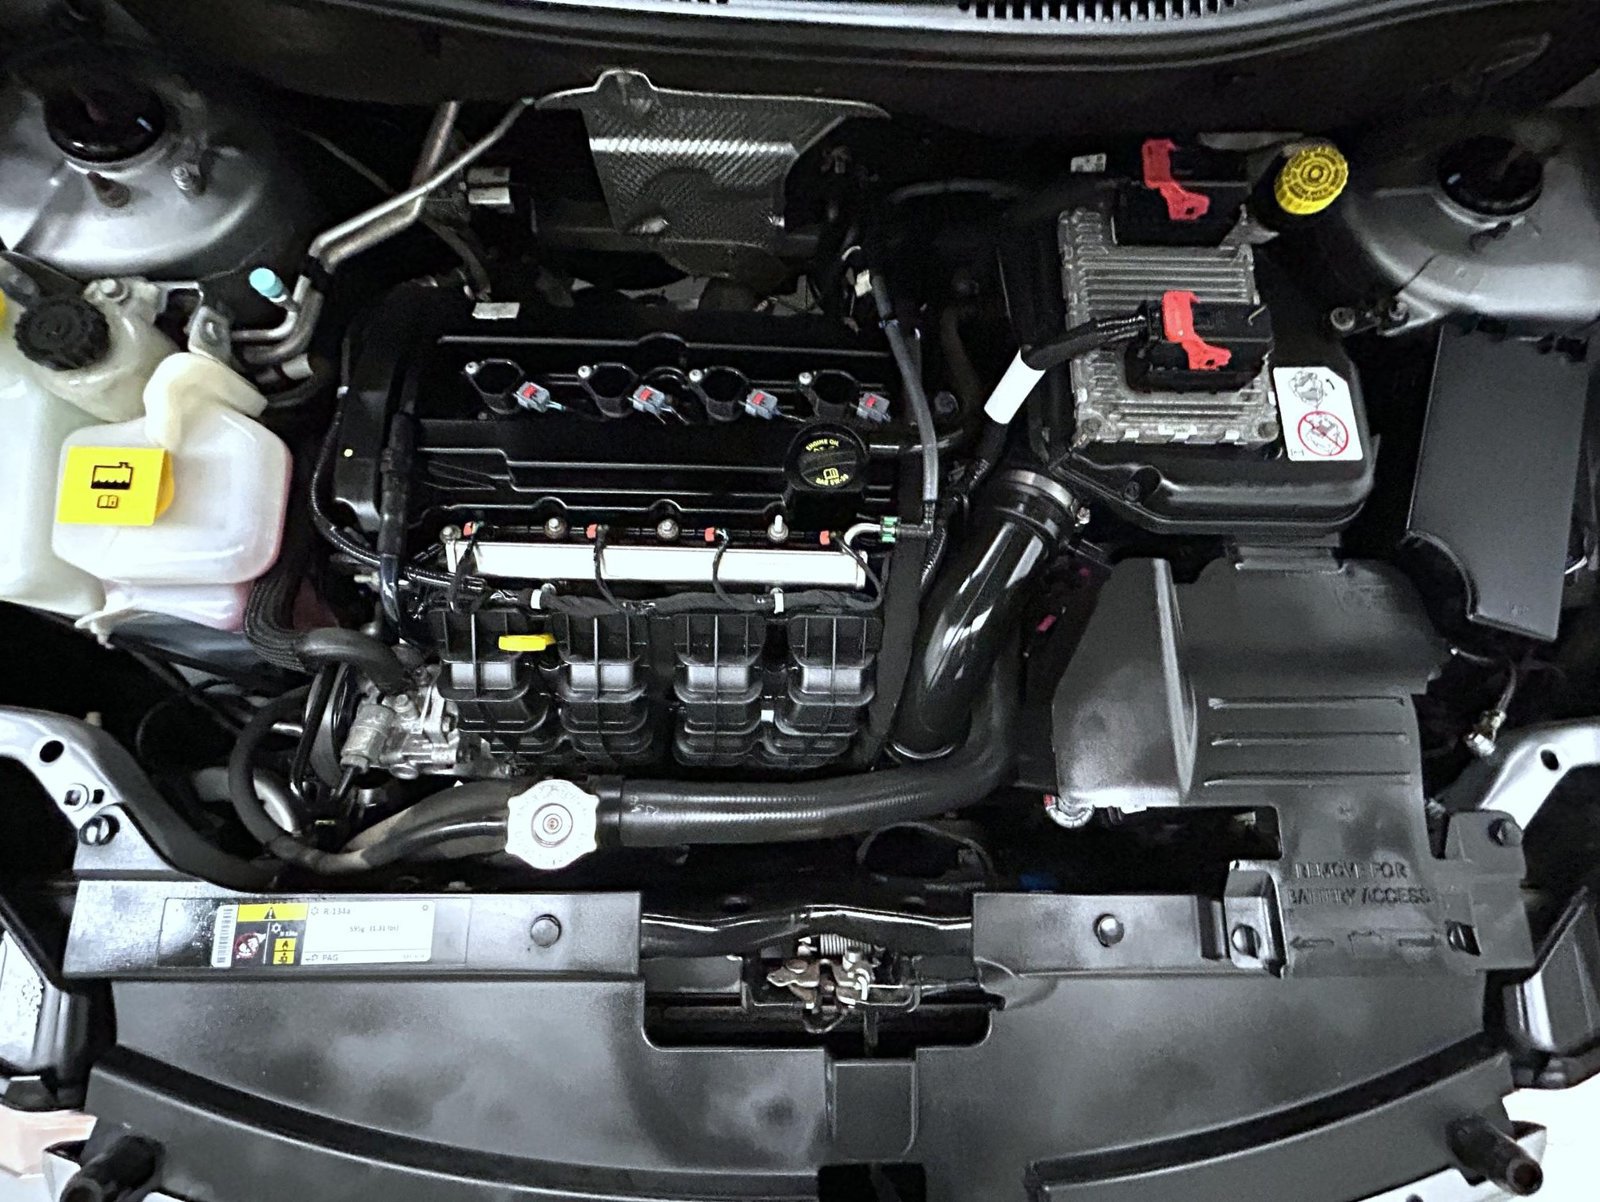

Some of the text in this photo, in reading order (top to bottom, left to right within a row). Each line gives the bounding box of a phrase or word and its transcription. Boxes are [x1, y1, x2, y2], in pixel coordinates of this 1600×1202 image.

[805, 438, 839, 452] ENGINE OIL
[1369, 861, 1408, 879] FOR
[1361, 886, 1431, 905] ACCESS
[322, 953, 339, 961] PAG
